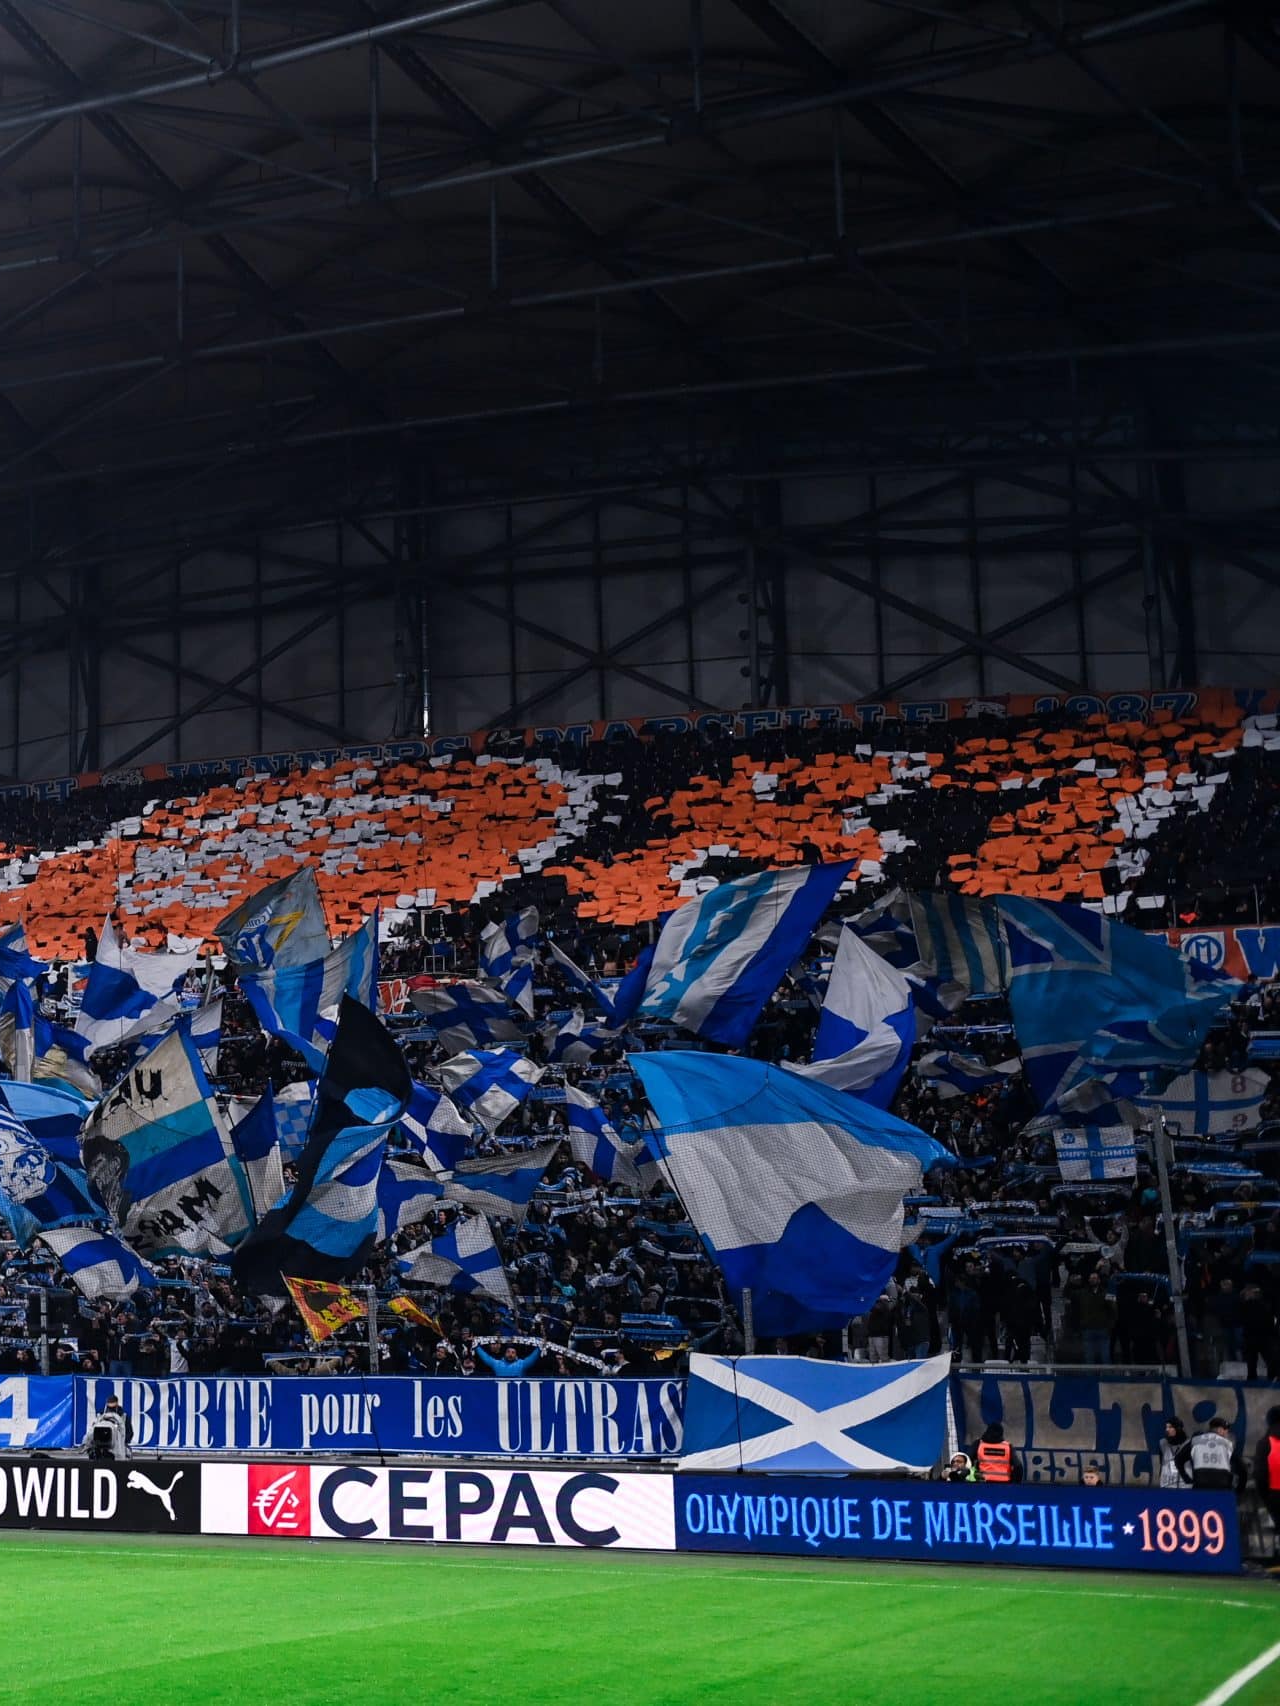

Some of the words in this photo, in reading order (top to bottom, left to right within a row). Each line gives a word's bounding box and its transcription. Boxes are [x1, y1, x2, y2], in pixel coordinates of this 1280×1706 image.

[300, 1392, 381, 1449] pour
[412, 1379, 463, 1439] les
[495, 1379, 684, 1454] ULTRAS
[317, 1467, 622, 1547] CEPAC
[685, 1492, 861, 1547] OLYMPIQUE
[871, 1497, 913, 1542] DE
[923, 1499, 1116, 1551] MARSEILLE
[1138, 1508, 1226, 1555] 1899
